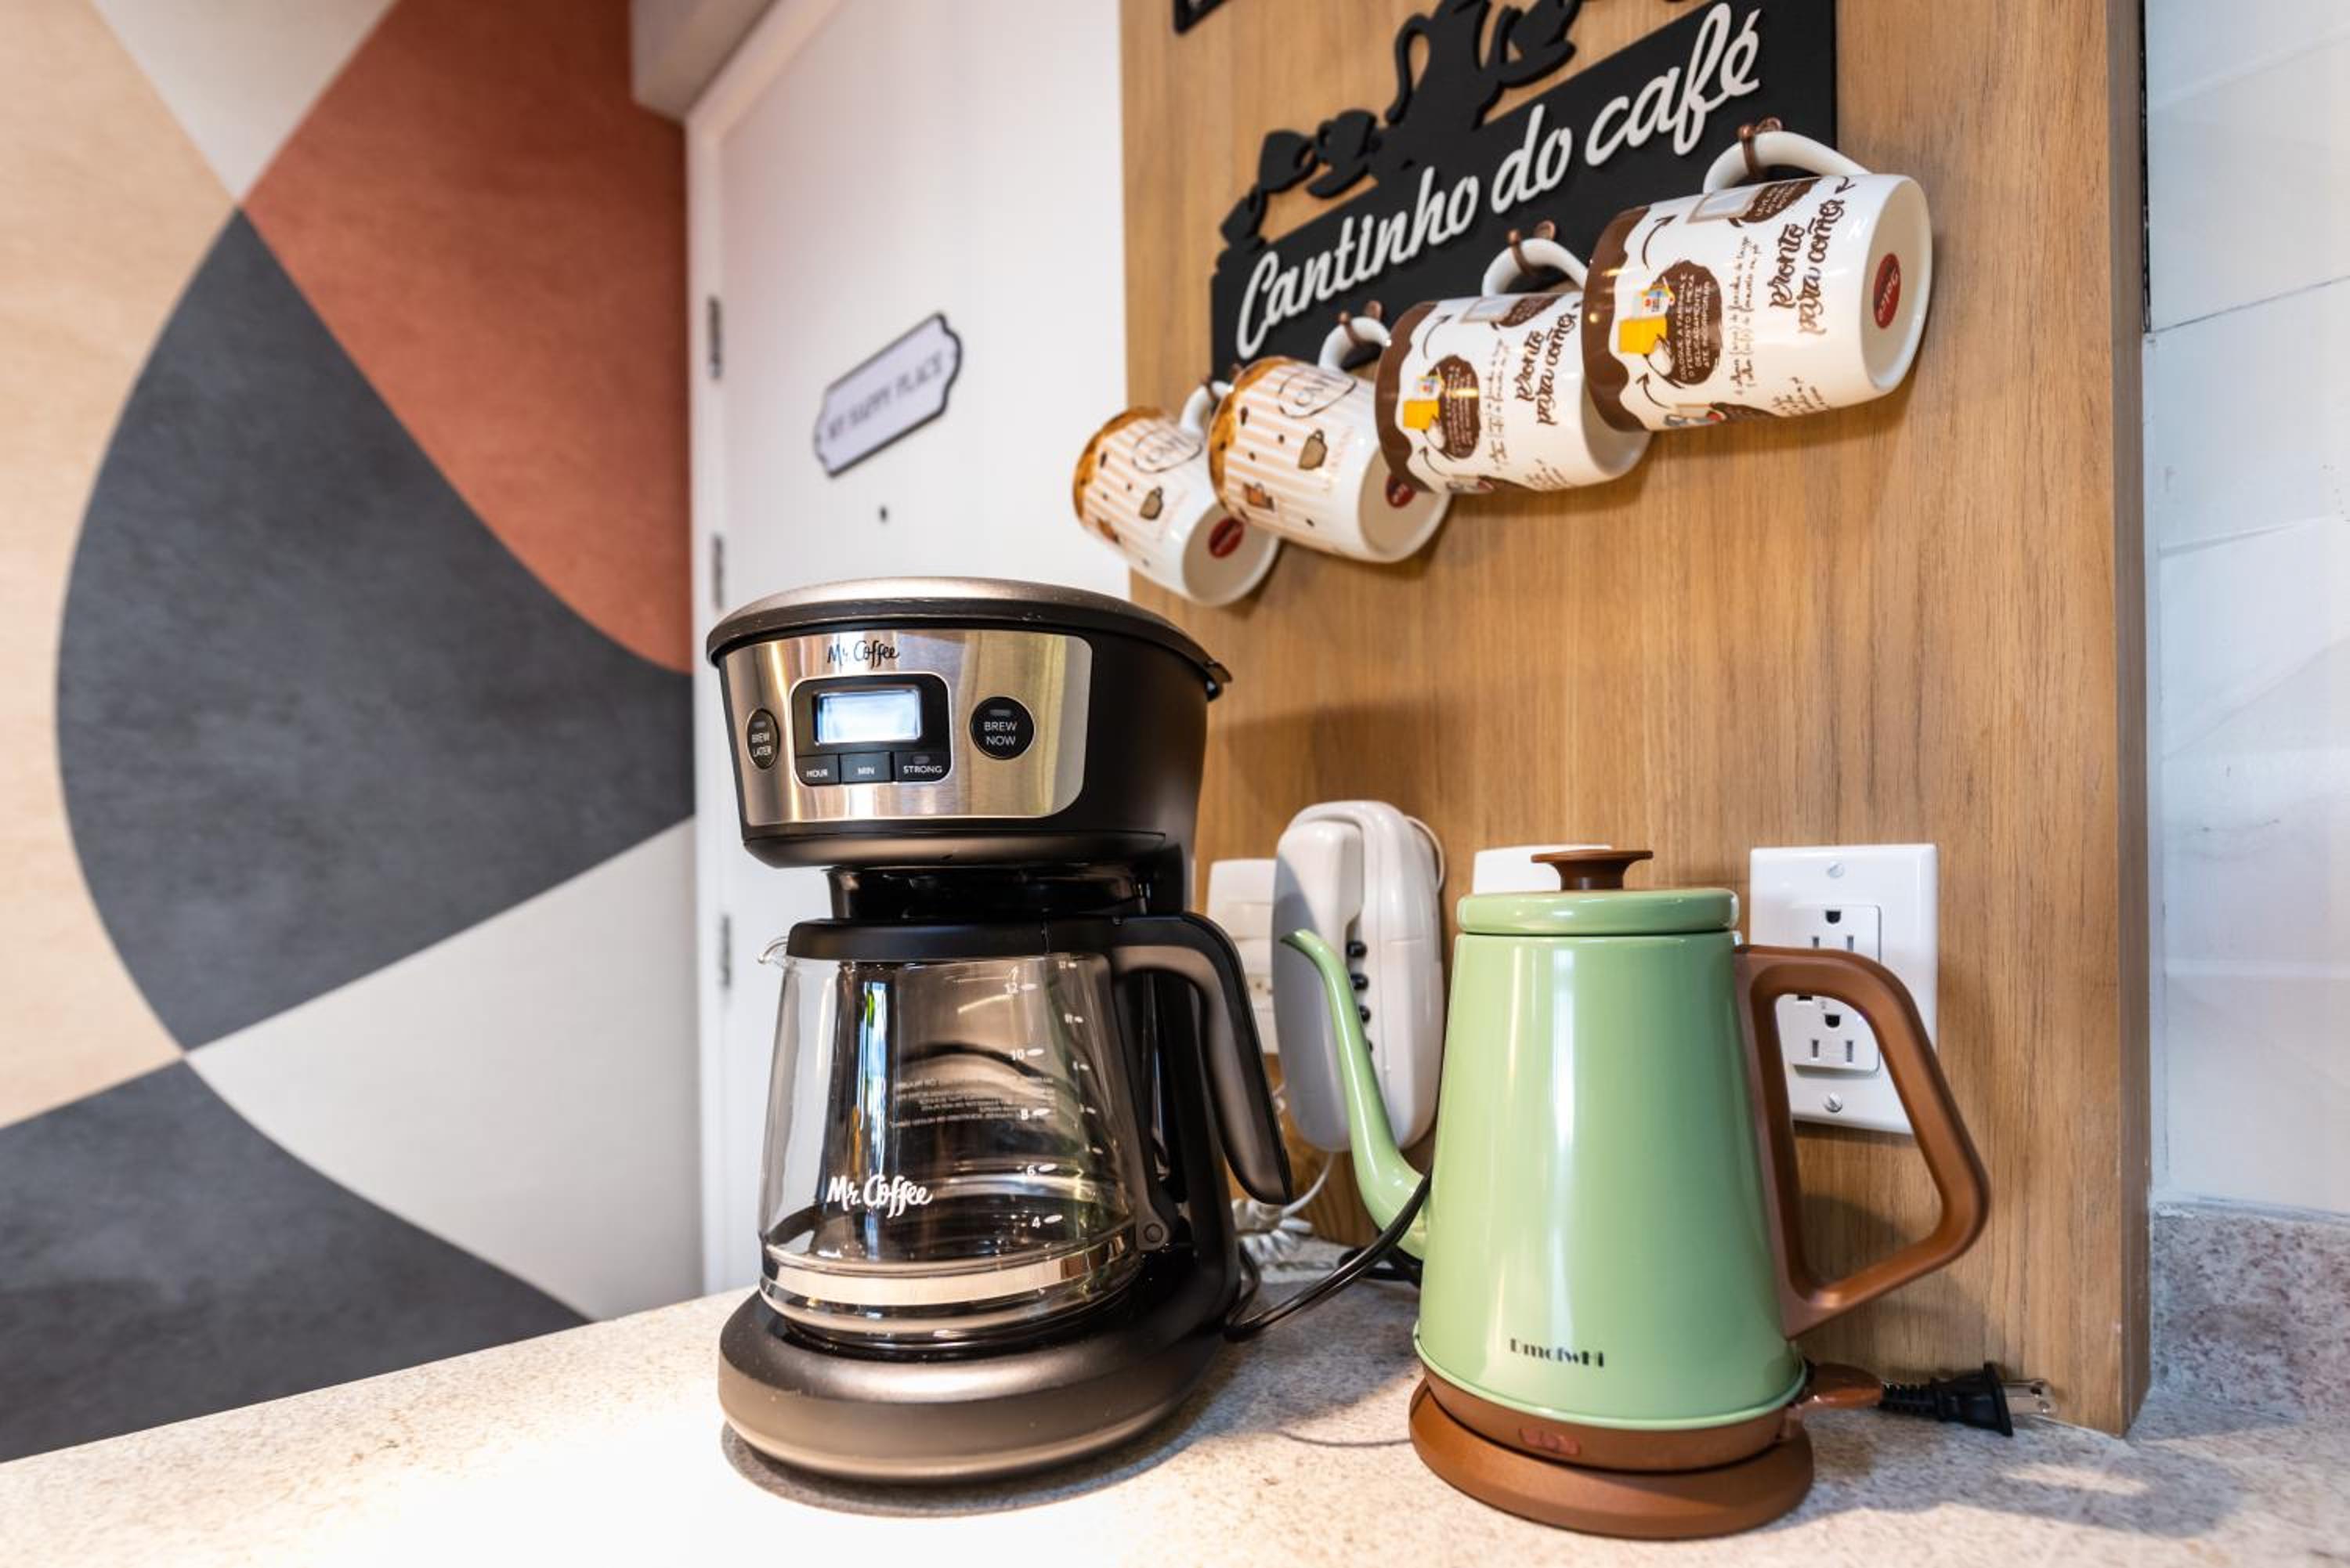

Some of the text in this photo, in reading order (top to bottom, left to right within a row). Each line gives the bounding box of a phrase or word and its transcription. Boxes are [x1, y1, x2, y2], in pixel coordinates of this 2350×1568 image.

[1236, 2, 1760, 359] Cantinho do café
[854, 640, 900, 670] Coffee
[983, 721, 1018, 732] BREW
[751, 732, 770, 743] BREW
[985, 734, 1017, 746] NOW
[753, 745, 772, 757] LATER
[806, 769, 828, 778] HOUR
[903, 765, 942, 774] STRONG
[1011, 1050, 1025, 1060] 10
[1026, 1165, 1036, 1176] 6
[826, 1174, 933, 1219] Mr. Coffee
[1032, 1216, 1041, 1228] 4
